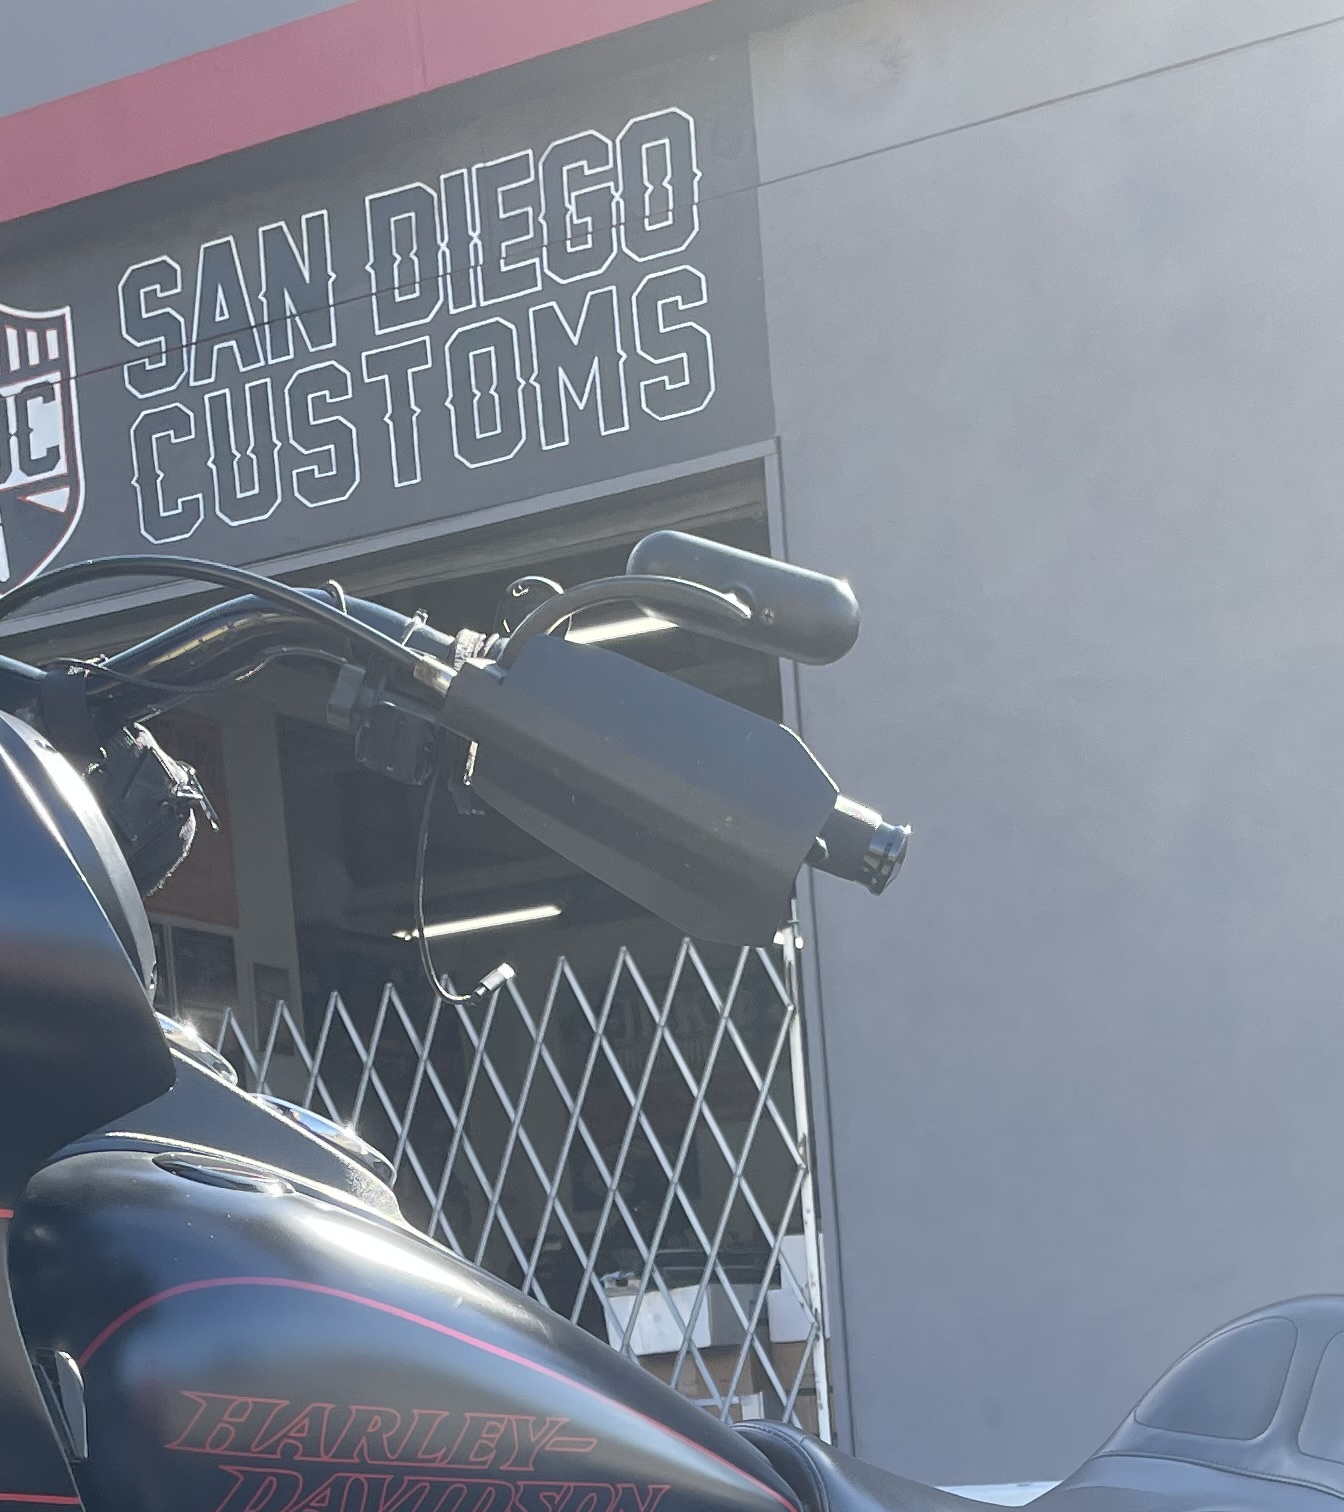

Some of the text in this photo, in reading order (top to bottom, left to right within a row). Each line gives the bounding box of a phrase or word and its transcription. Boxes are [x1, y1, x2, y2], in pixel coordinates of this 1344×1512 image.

[118, 107, 702, 399] SAN DIEGO
[129, 265, 716, 545] CUSTOMS
